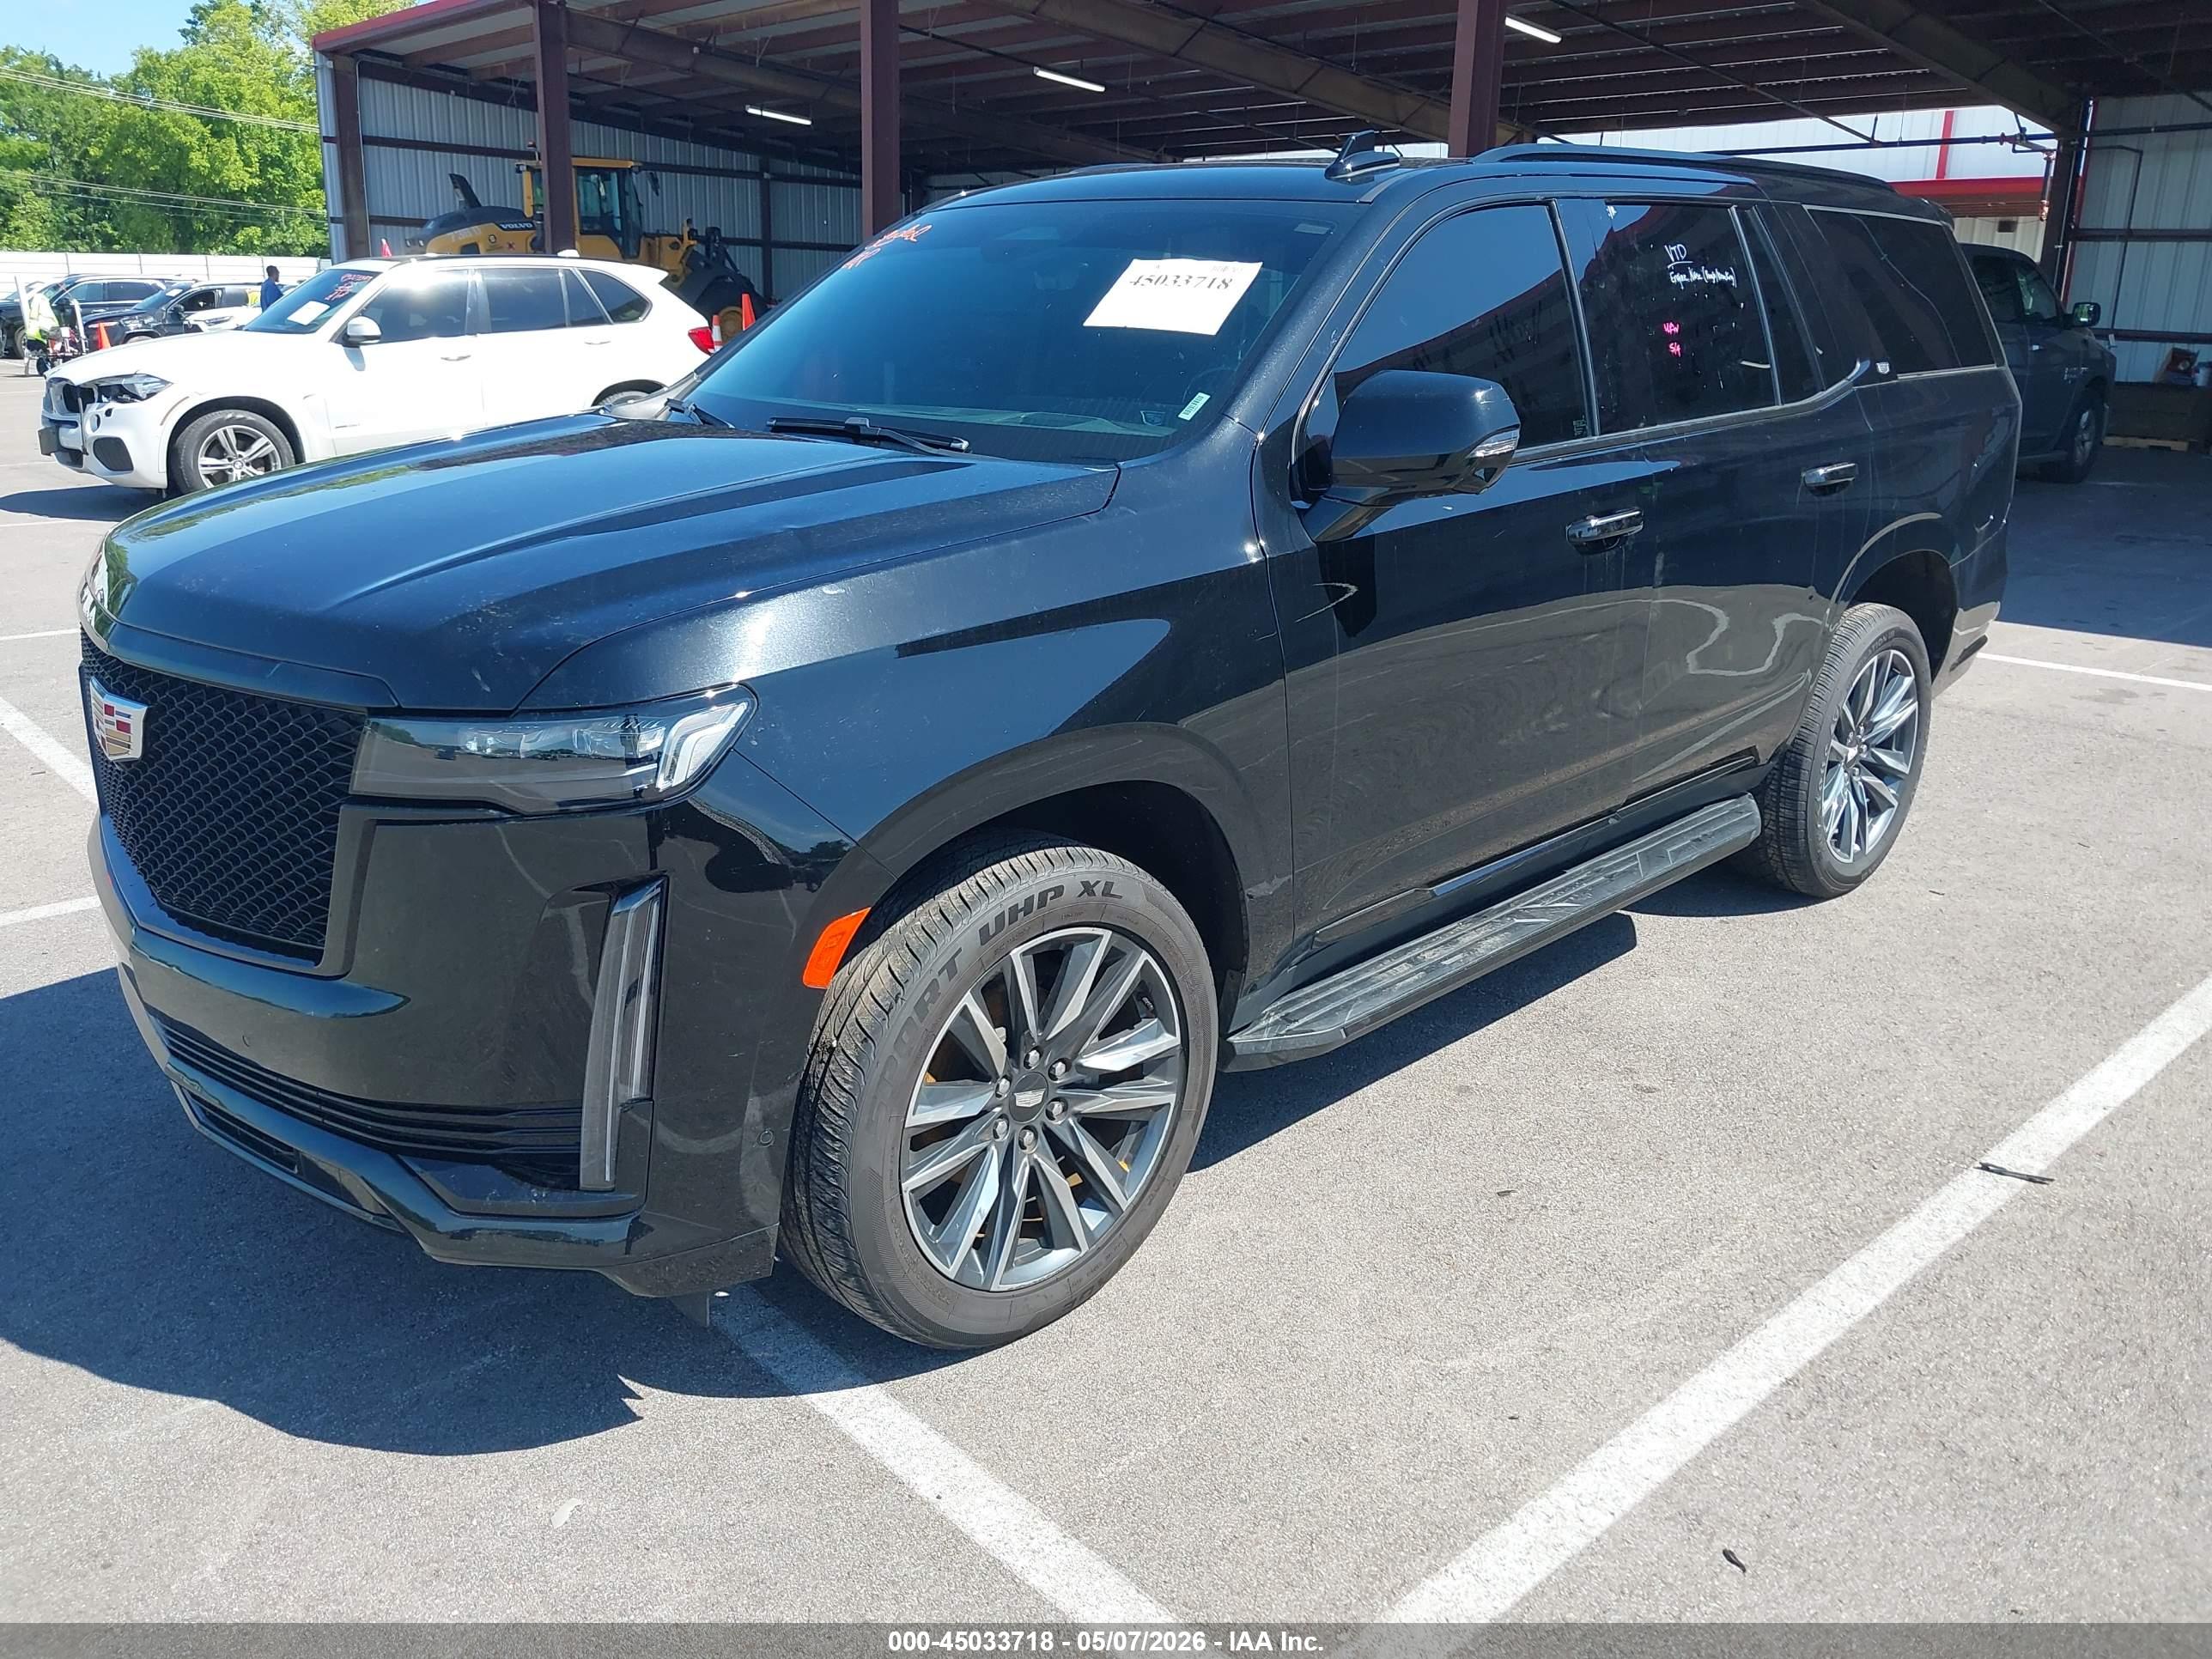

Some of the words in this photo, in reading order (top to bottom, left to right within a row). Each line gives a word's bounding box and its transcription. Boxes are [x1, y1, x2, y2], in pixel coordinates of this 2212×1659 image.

[1129, 274, 1233, 289] 45033718
[979, 884, 1065, 945] UHP
[1077, 880, 1123, 900] XL
